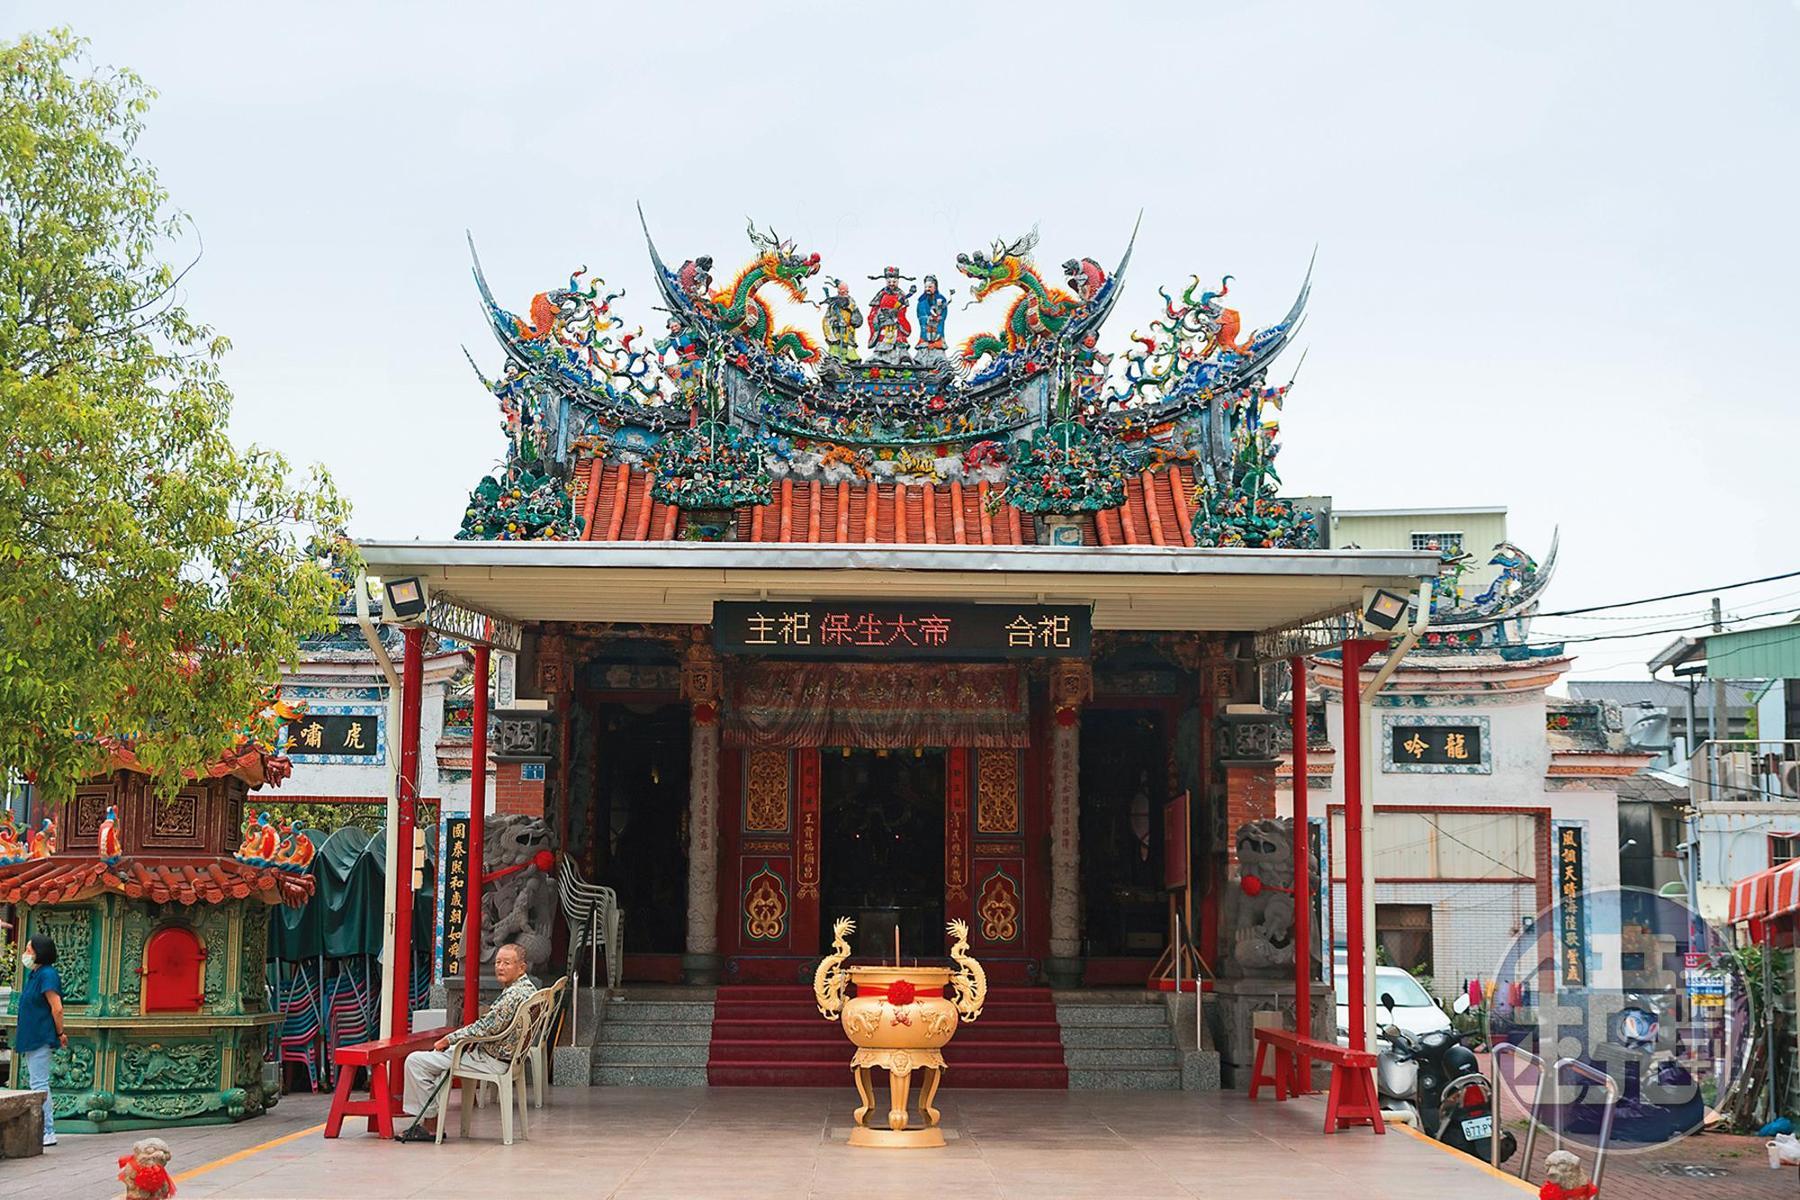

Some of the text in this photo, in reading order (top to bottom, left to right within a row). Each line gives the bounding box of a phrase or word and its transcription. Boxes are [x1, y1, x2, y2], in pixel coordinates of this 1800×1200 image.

[744, 612, 1071, 648] 主祀 保生大帝 合祀
